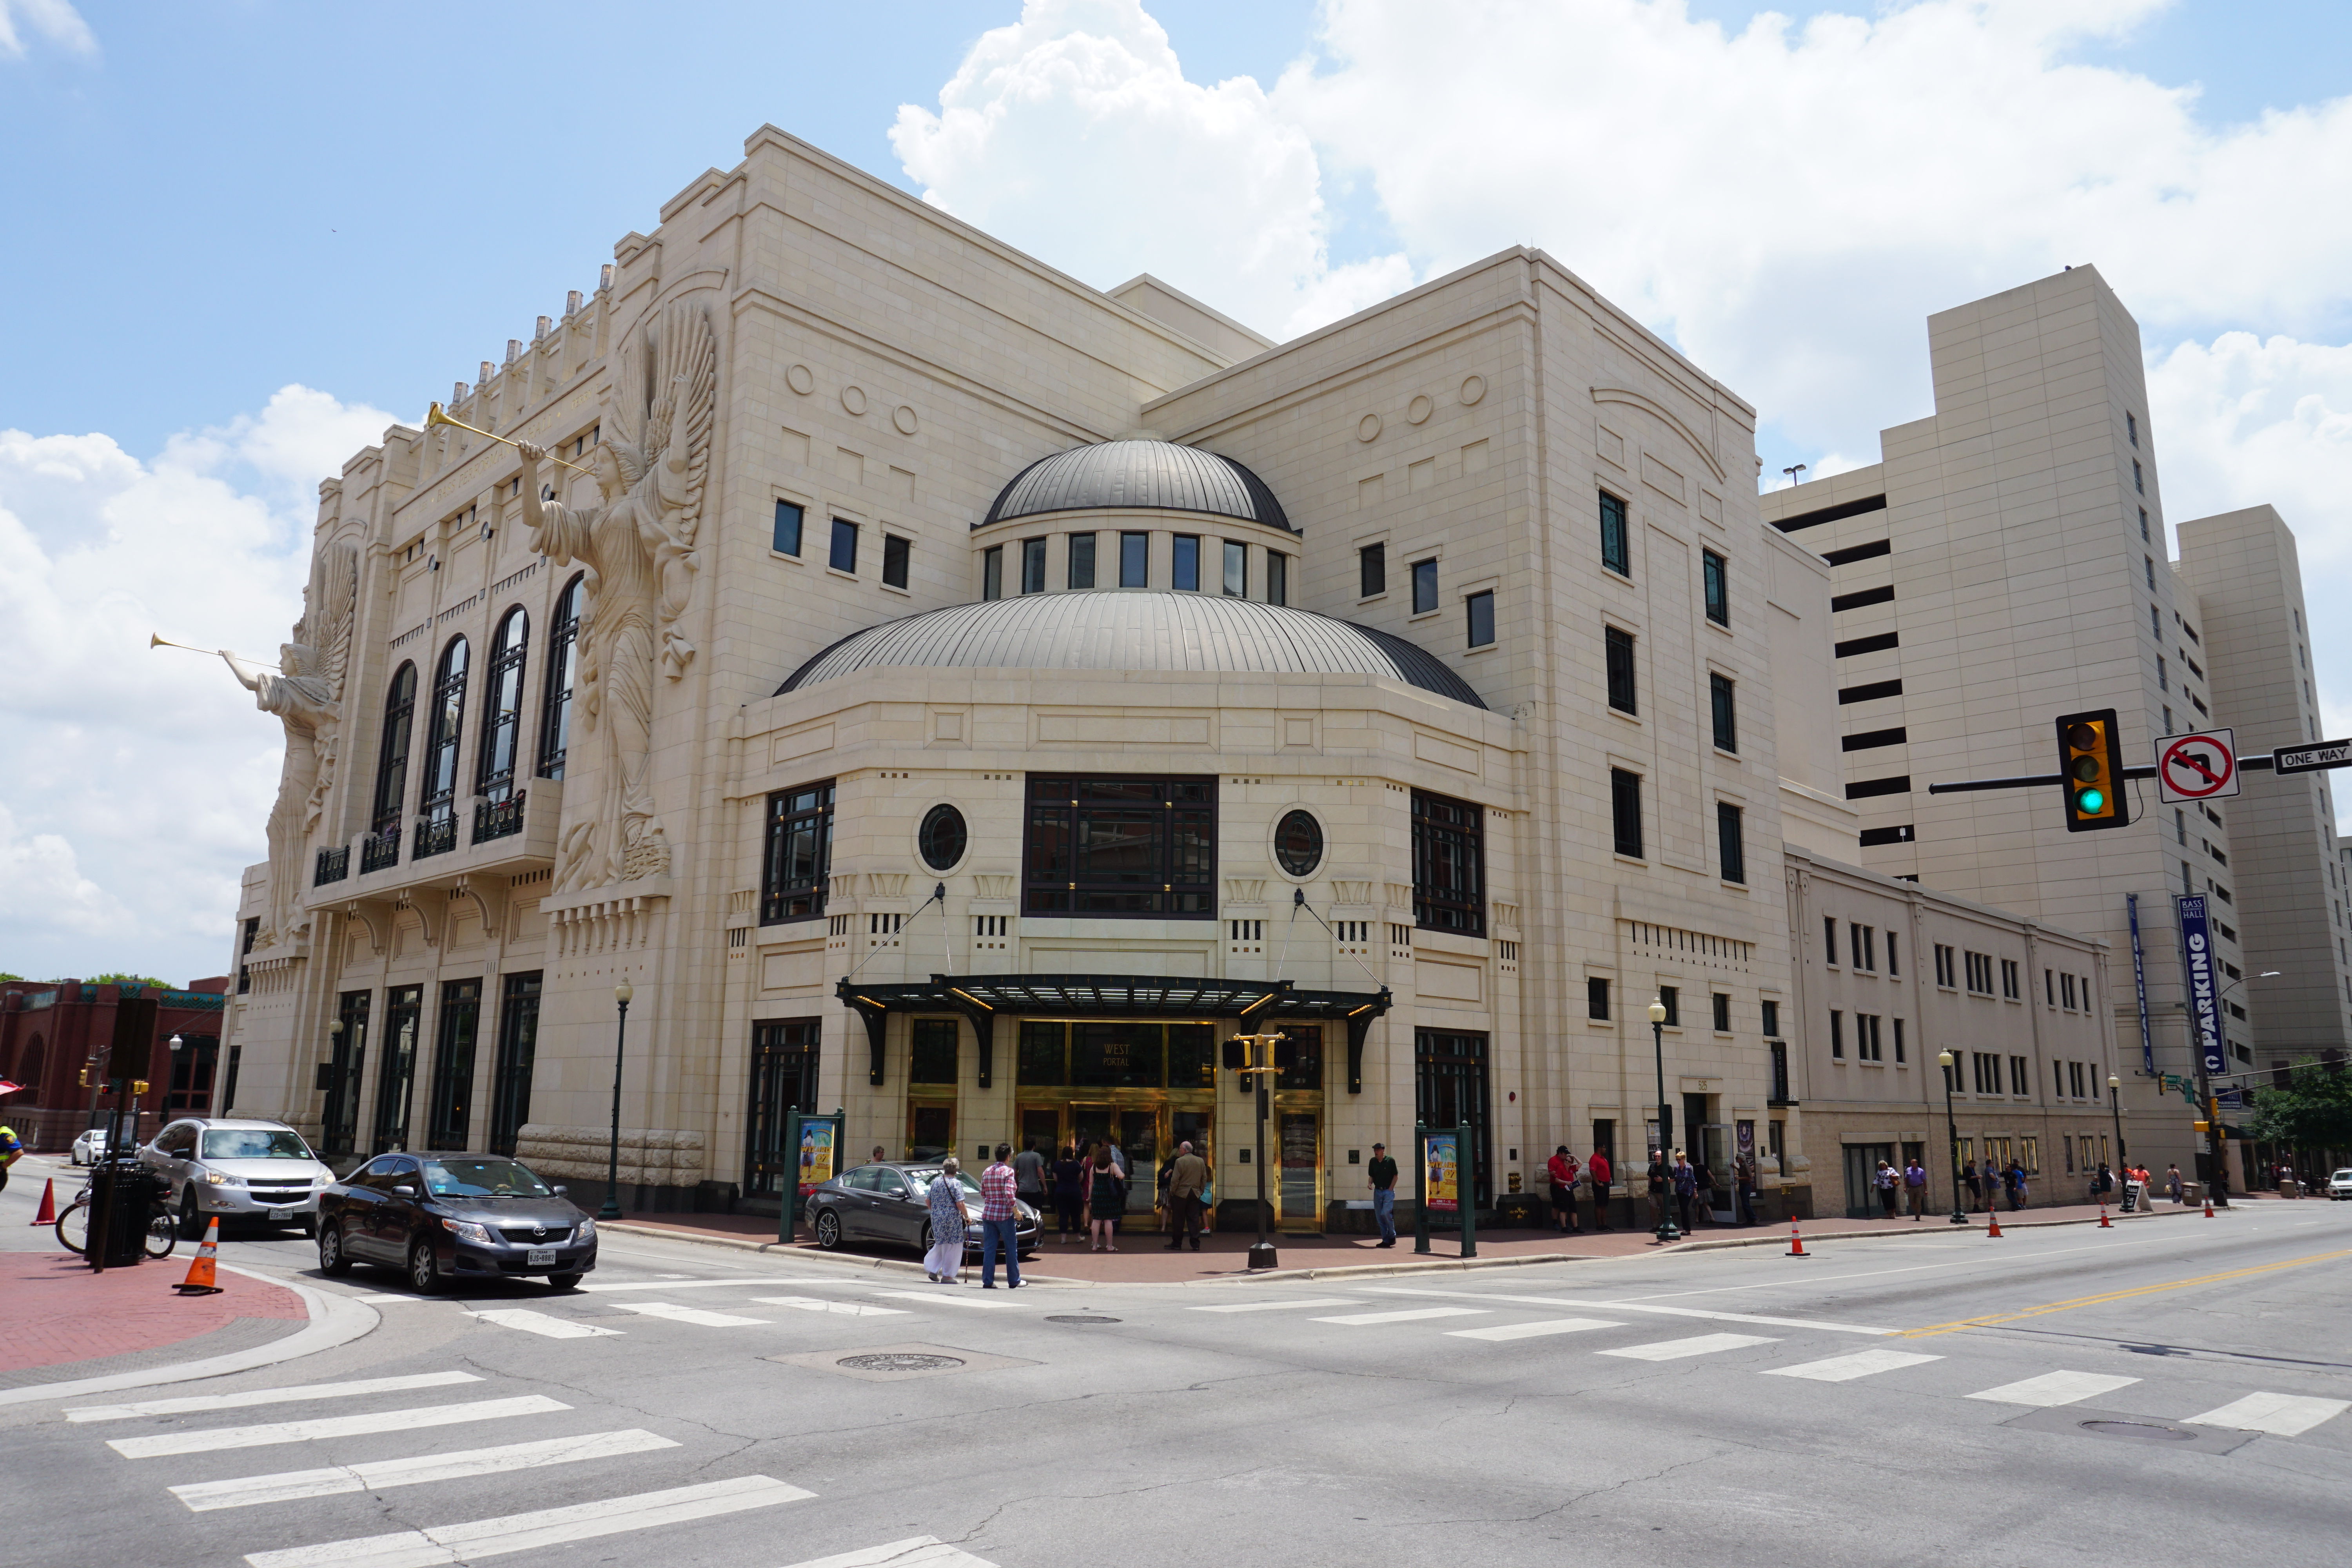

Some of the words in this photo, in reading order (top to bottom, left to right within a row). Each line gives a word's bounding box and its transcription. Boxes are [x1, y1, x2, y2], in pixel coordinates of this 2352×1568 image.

[2286, 753, 2314, 766] ONE
[2318, 748, 2347, 761] WAY
[2182, 900, 2203, 908] BASS
[2183, 911, 2204, 919] HALL
[2189, 933, 2218, 1046] PARKING
[1104, 1044, 1130, 1054] WEST
[1103, 1058, 1129, 1066] PORTAL
[1699, 1080, 1707, 1091] 525
